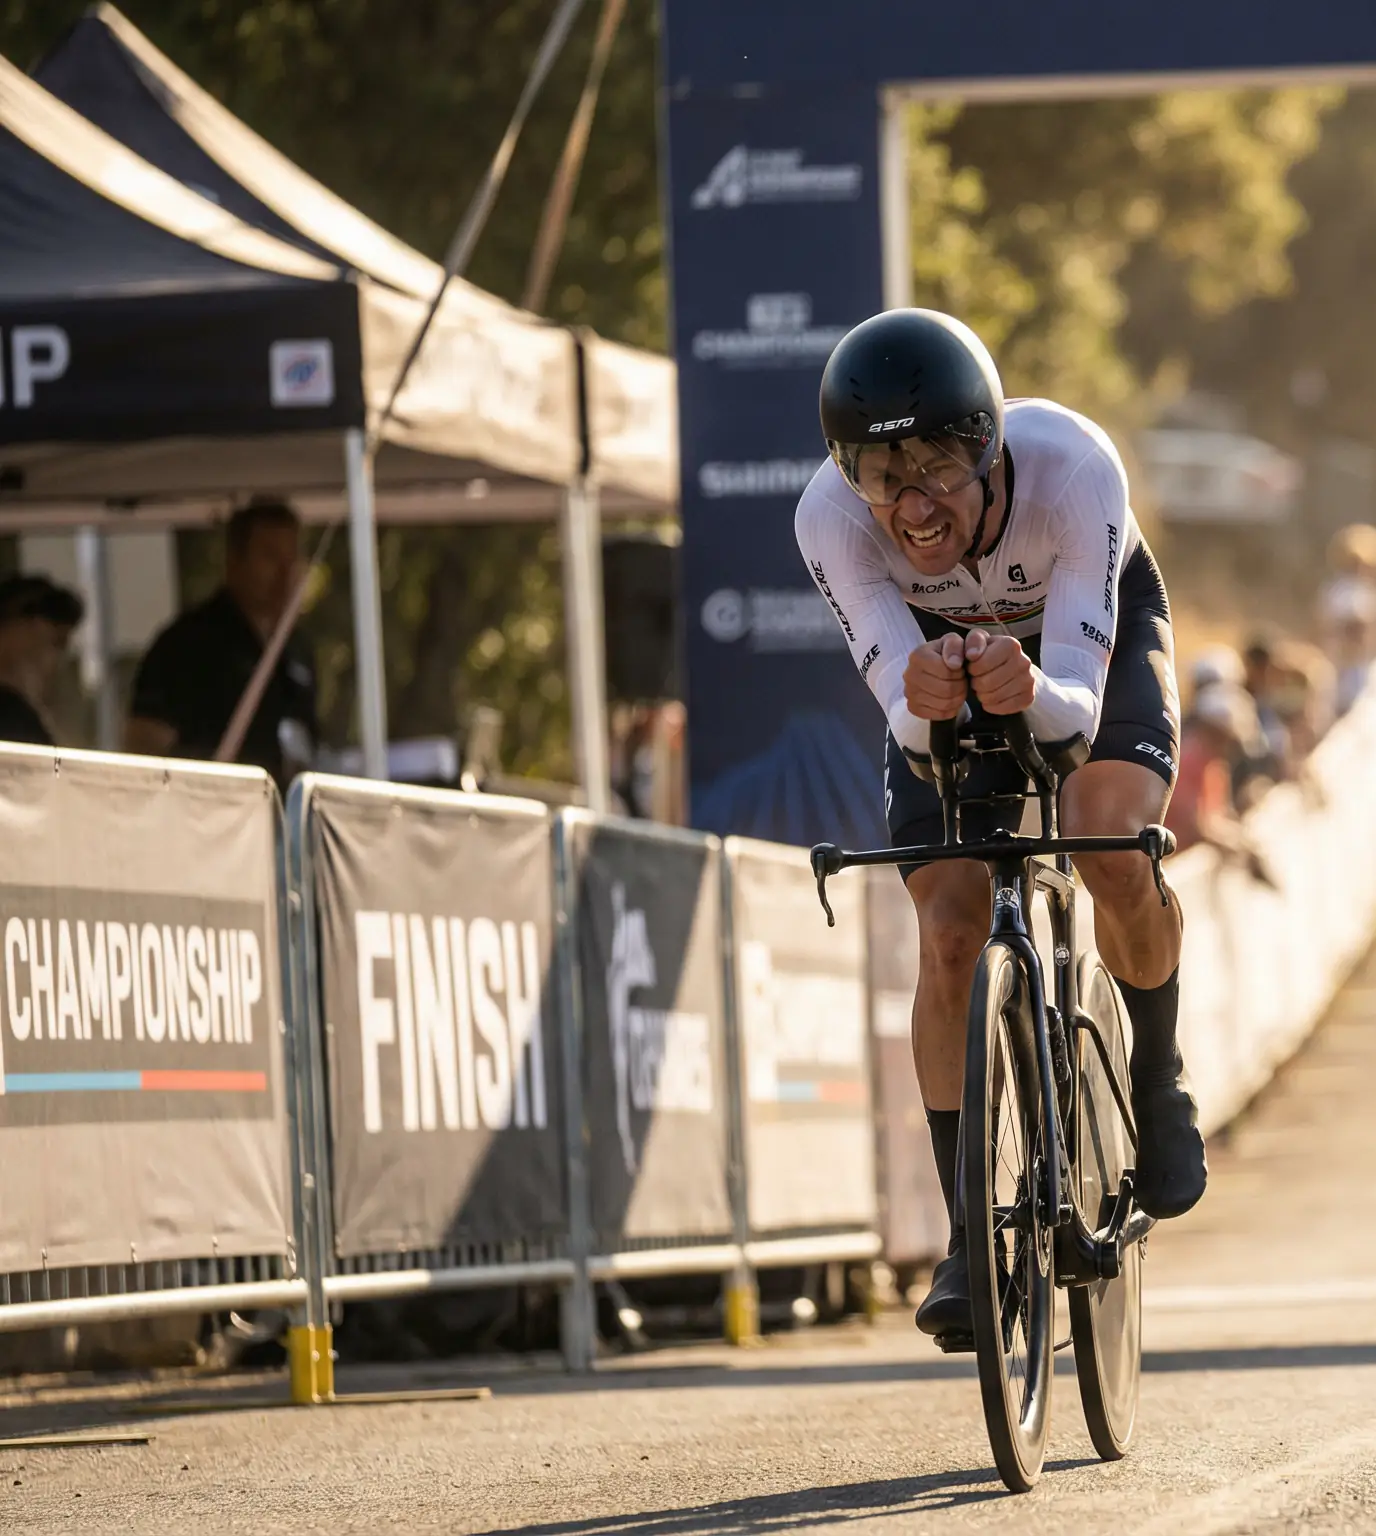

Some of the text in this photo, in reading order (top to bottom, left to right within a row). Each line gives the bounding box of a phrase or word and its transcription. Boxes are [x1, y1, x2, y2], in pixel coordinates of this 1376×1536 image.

[0, 325, 69, 408] P
[5, 917, 262, 1043] CHAMPIONSHIP
[355, 911, 548, 1133] FINISH
